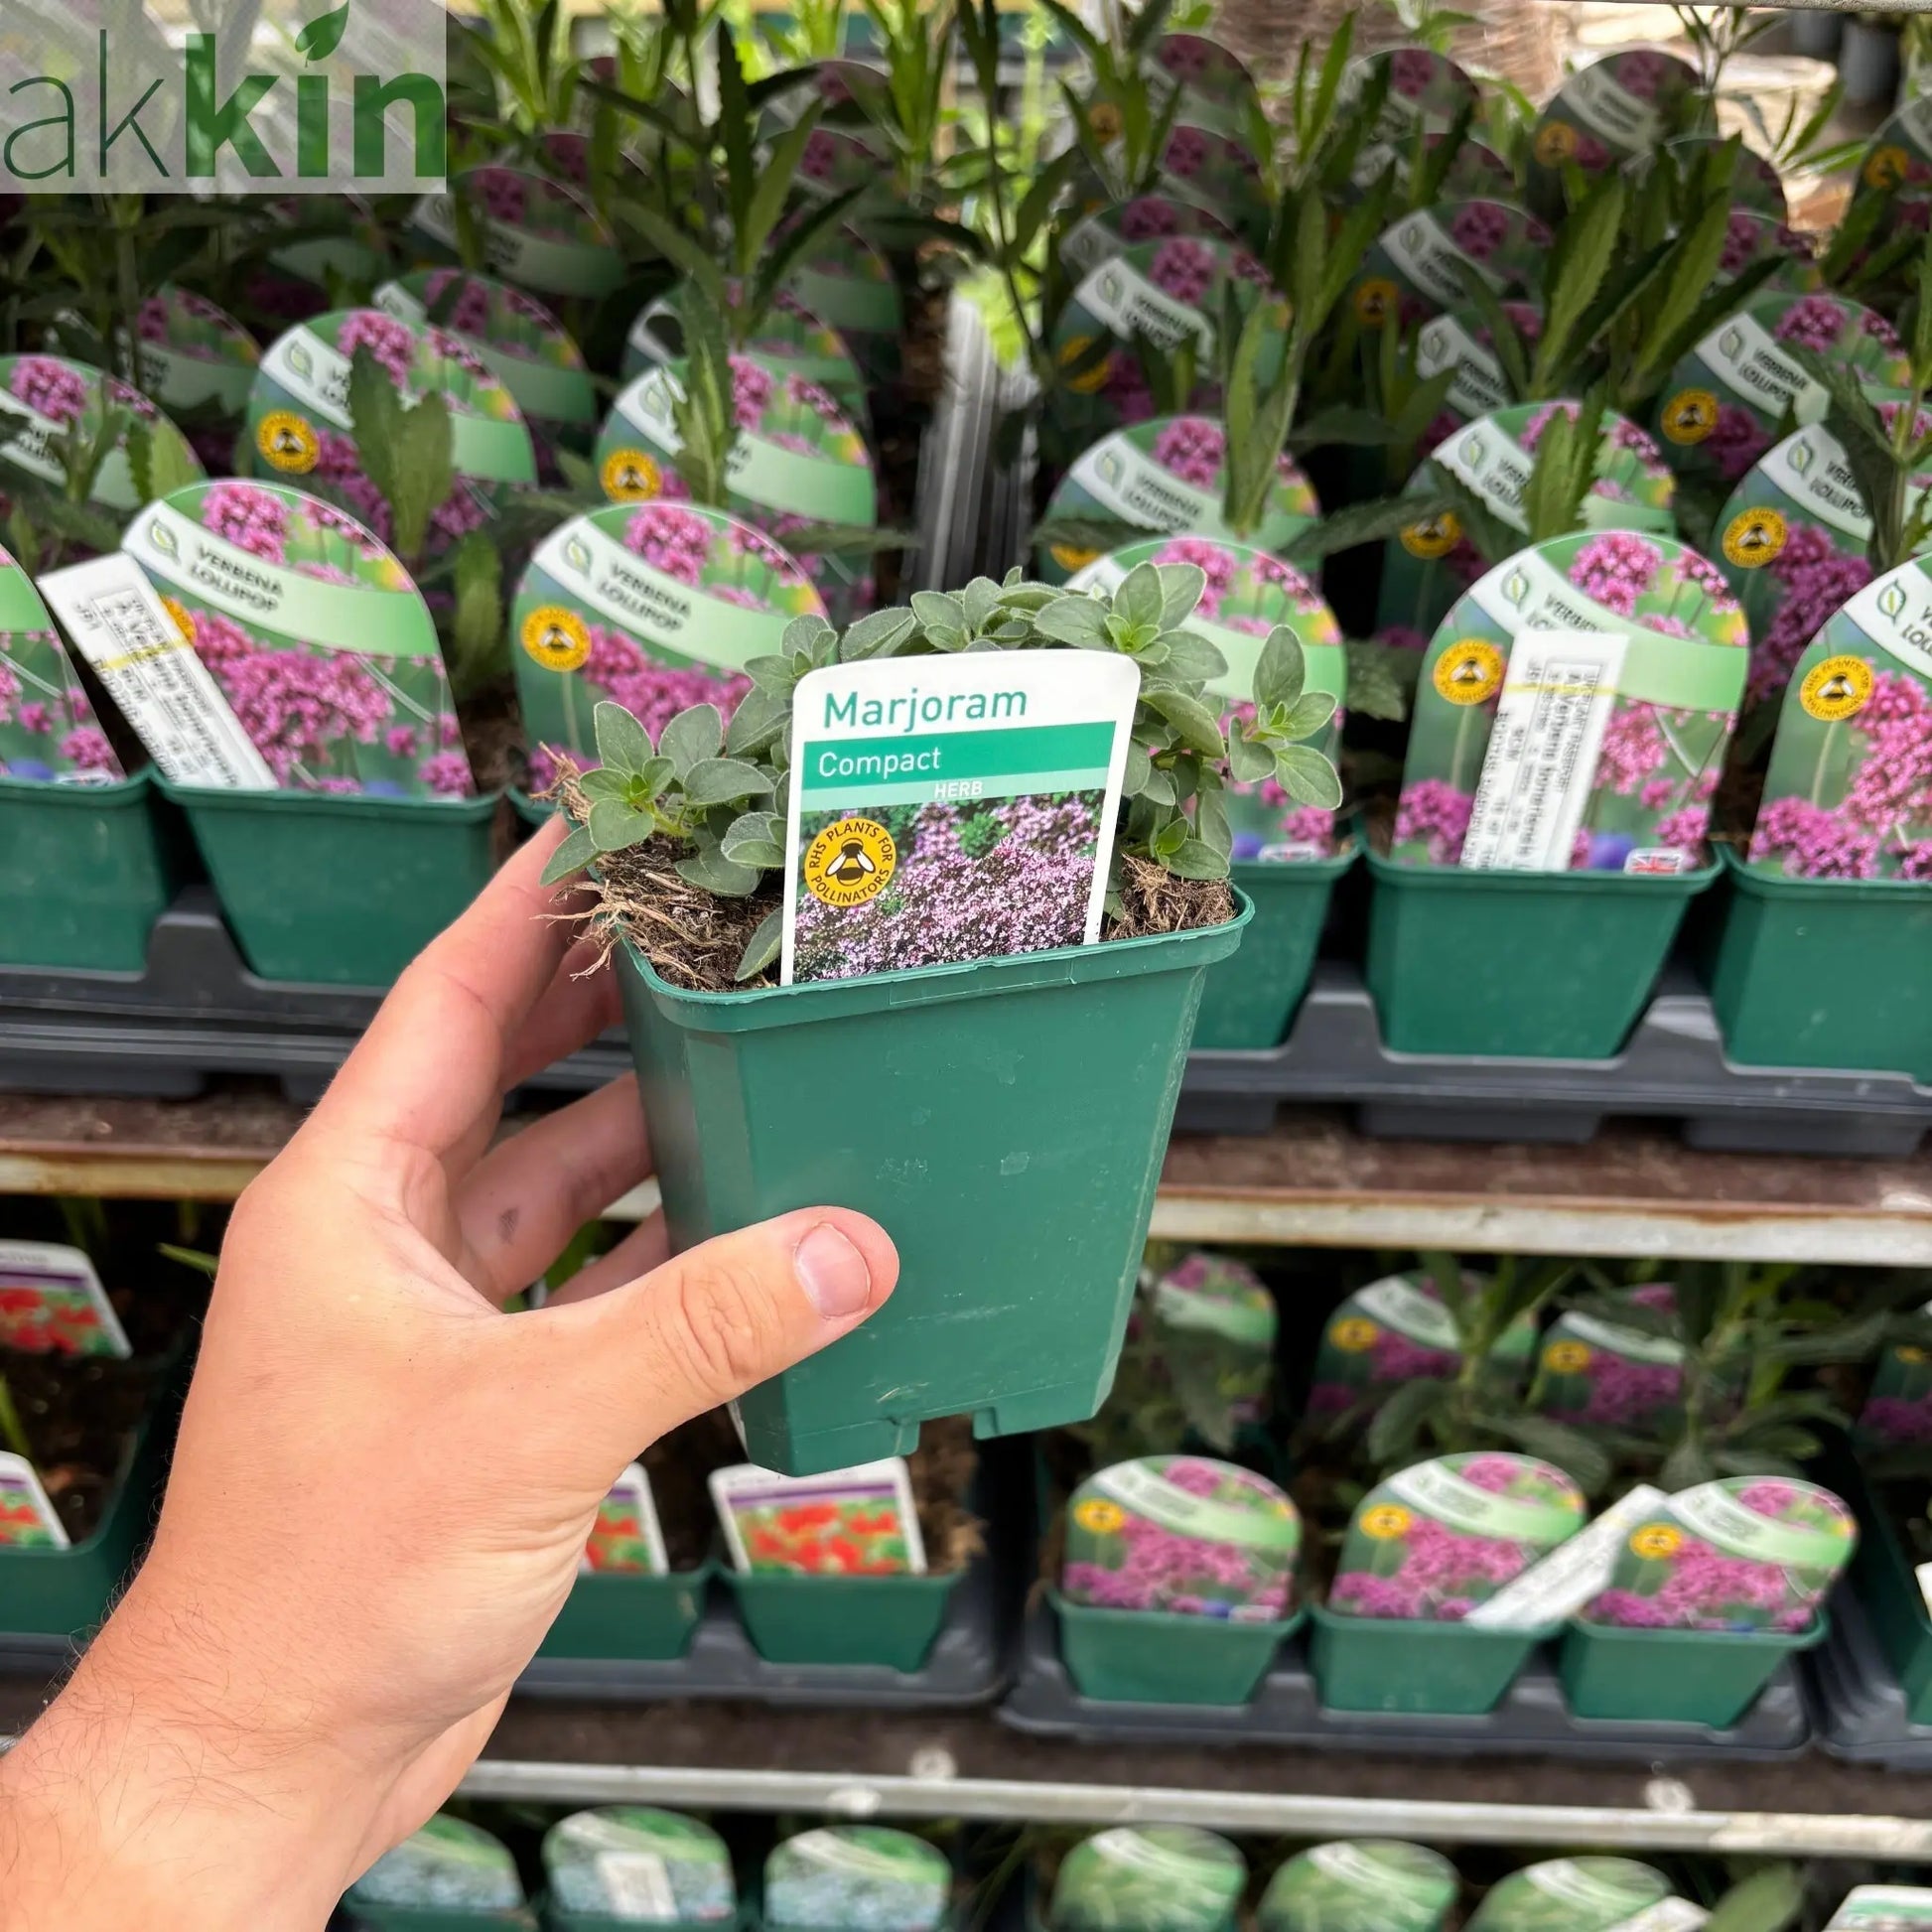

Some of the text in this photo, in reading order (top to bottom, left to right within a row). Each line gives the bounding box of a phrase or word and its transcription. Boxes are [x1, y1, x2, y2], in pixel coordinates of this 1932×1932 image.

[190, 563, 279, 613] LOLLIPOP
[197, 542, 284, 597] VERBENA
[823, 687, 1028, 733] Marjoram
[819, 747, 941, 779] Compact
[934, 780, 984, 799] HERB
[809, 822, 894, 869] RHS PLANTS FOR
[811, 869, 890, 902] POLLINATORS
